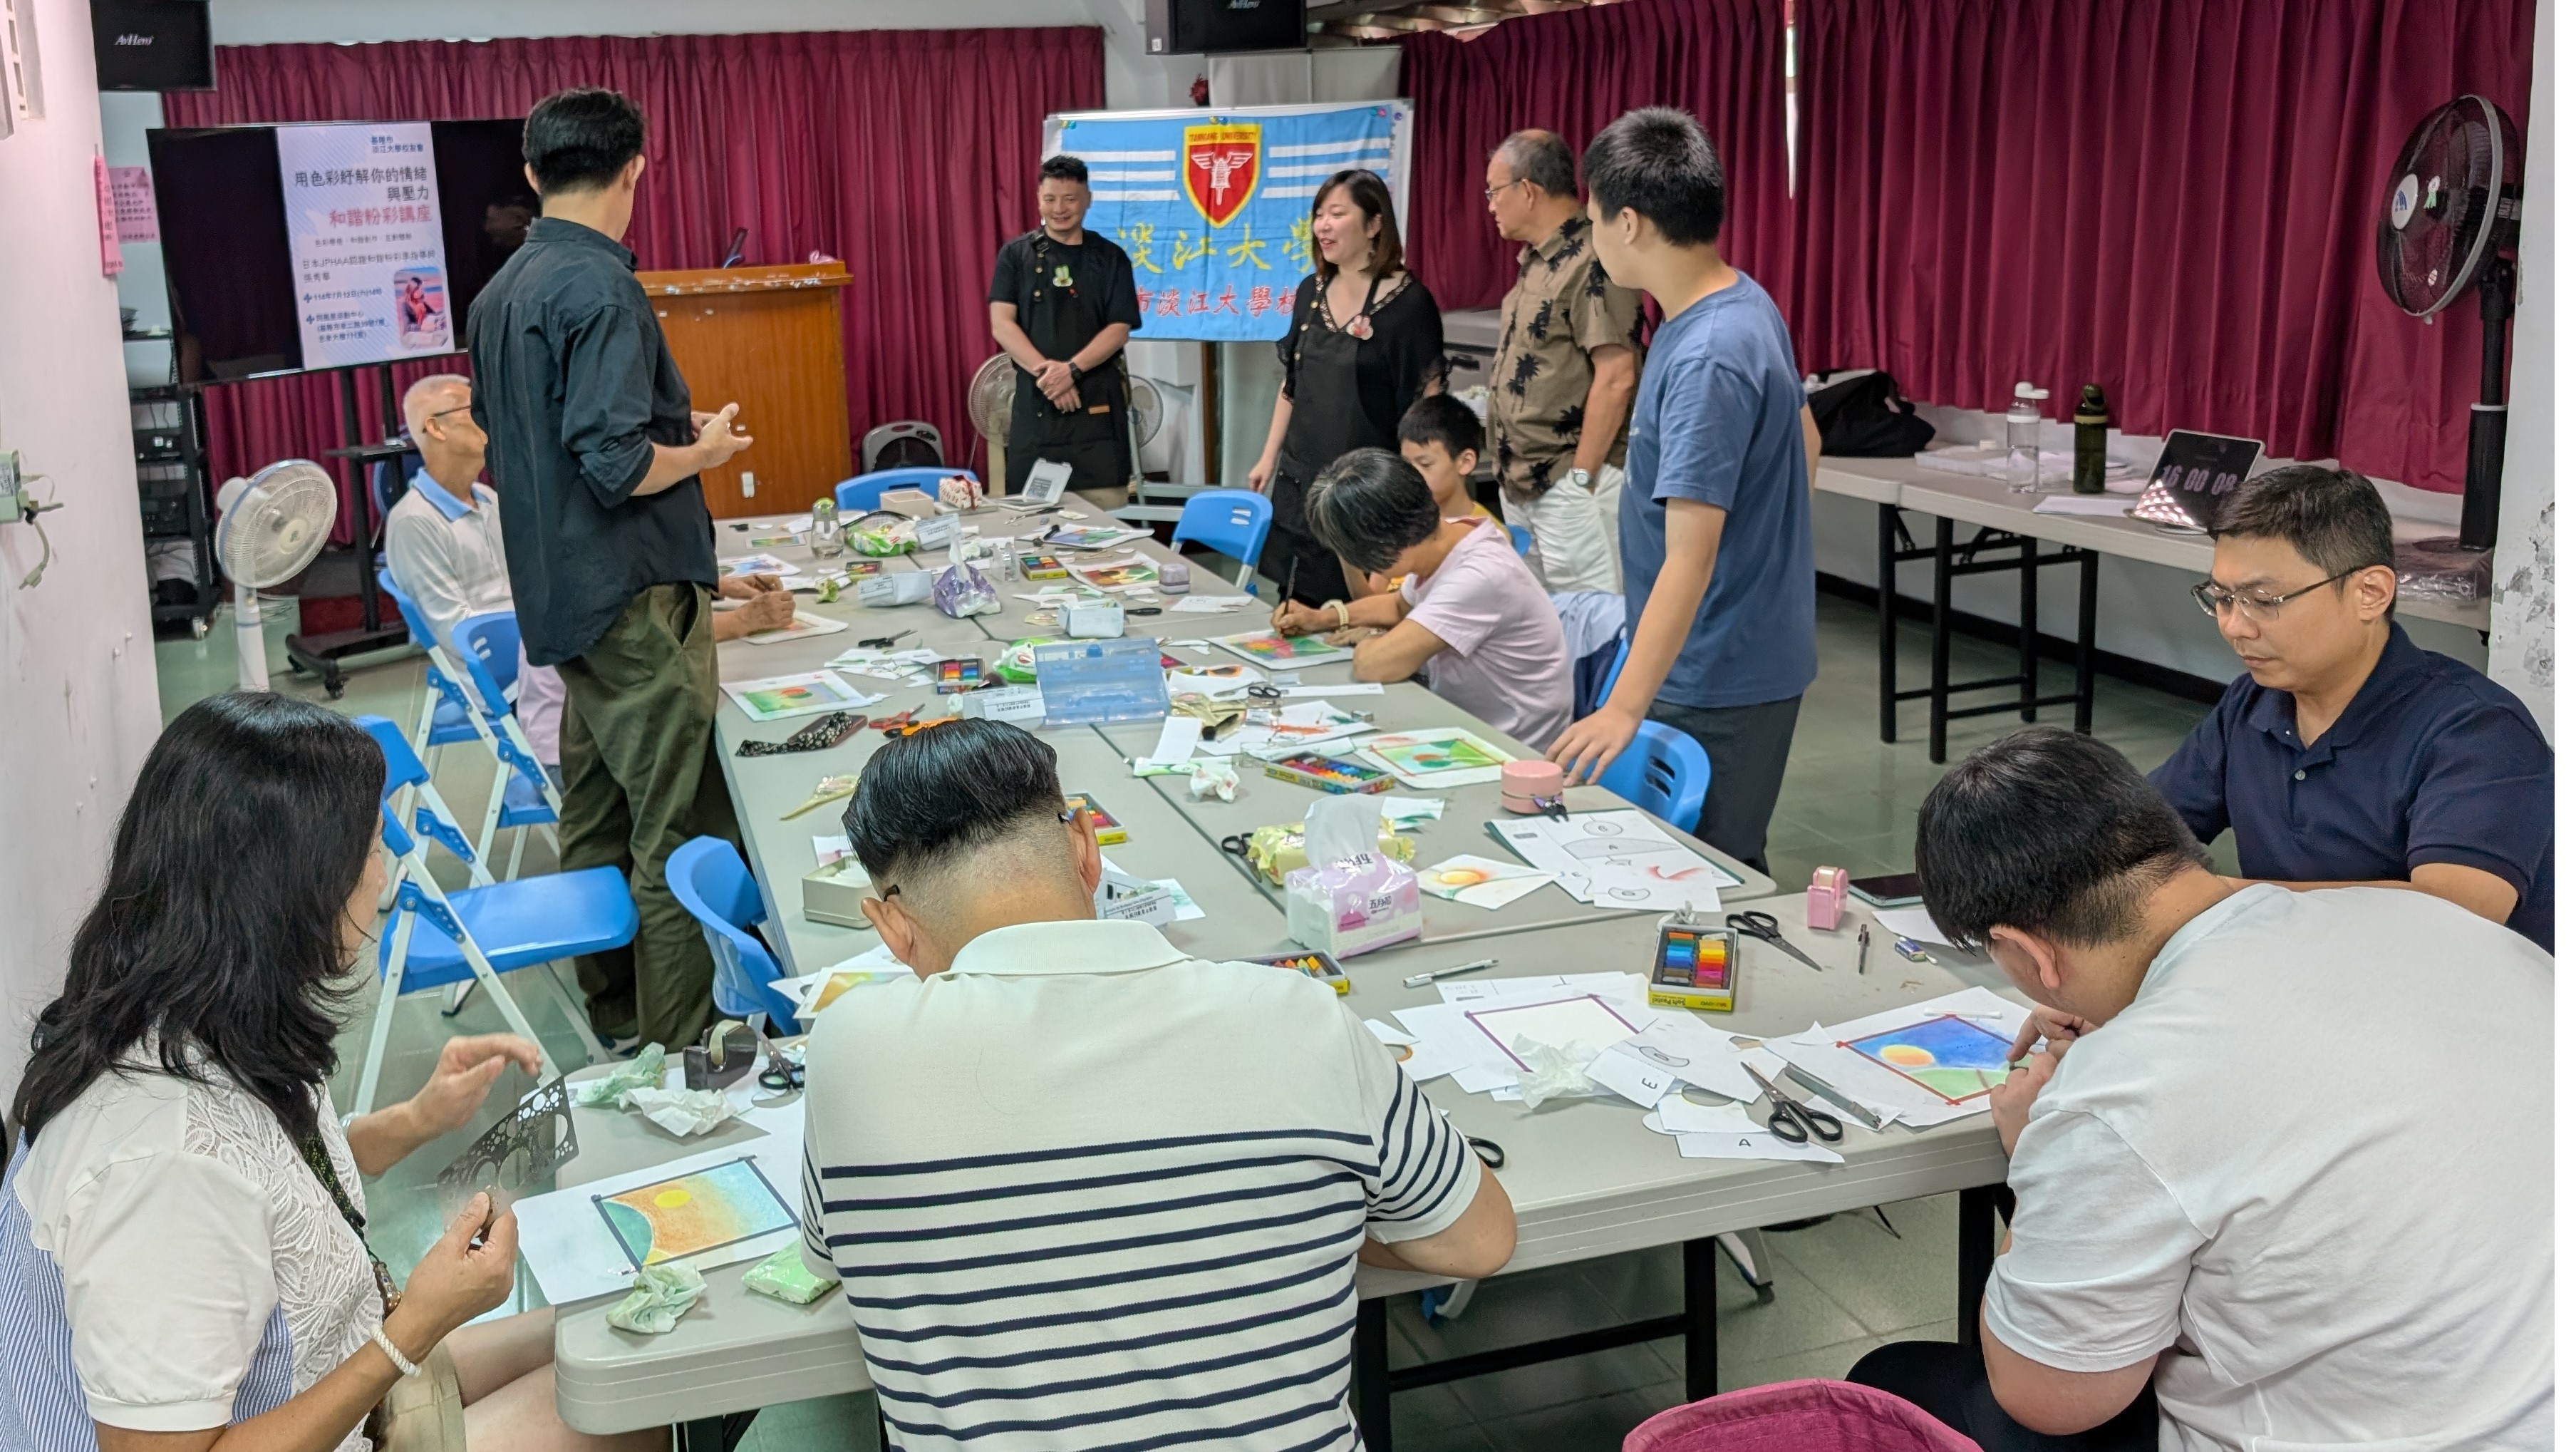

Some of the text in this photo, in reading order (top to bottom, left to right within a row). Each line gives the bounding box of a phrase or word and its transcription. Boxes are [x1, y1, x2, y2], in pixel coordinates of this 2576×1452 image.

[295, 166, 428, 187] 用色彩紓解你的情緒
[387, 185, 429, 202] 與壓力
[329, 205, 432, 227] 和諧粉彩講座
[2161, 464, 2182, 488] 16
[2183, 468, 2210, 492] 00
[1739, 1138, 1752, 1147] A
